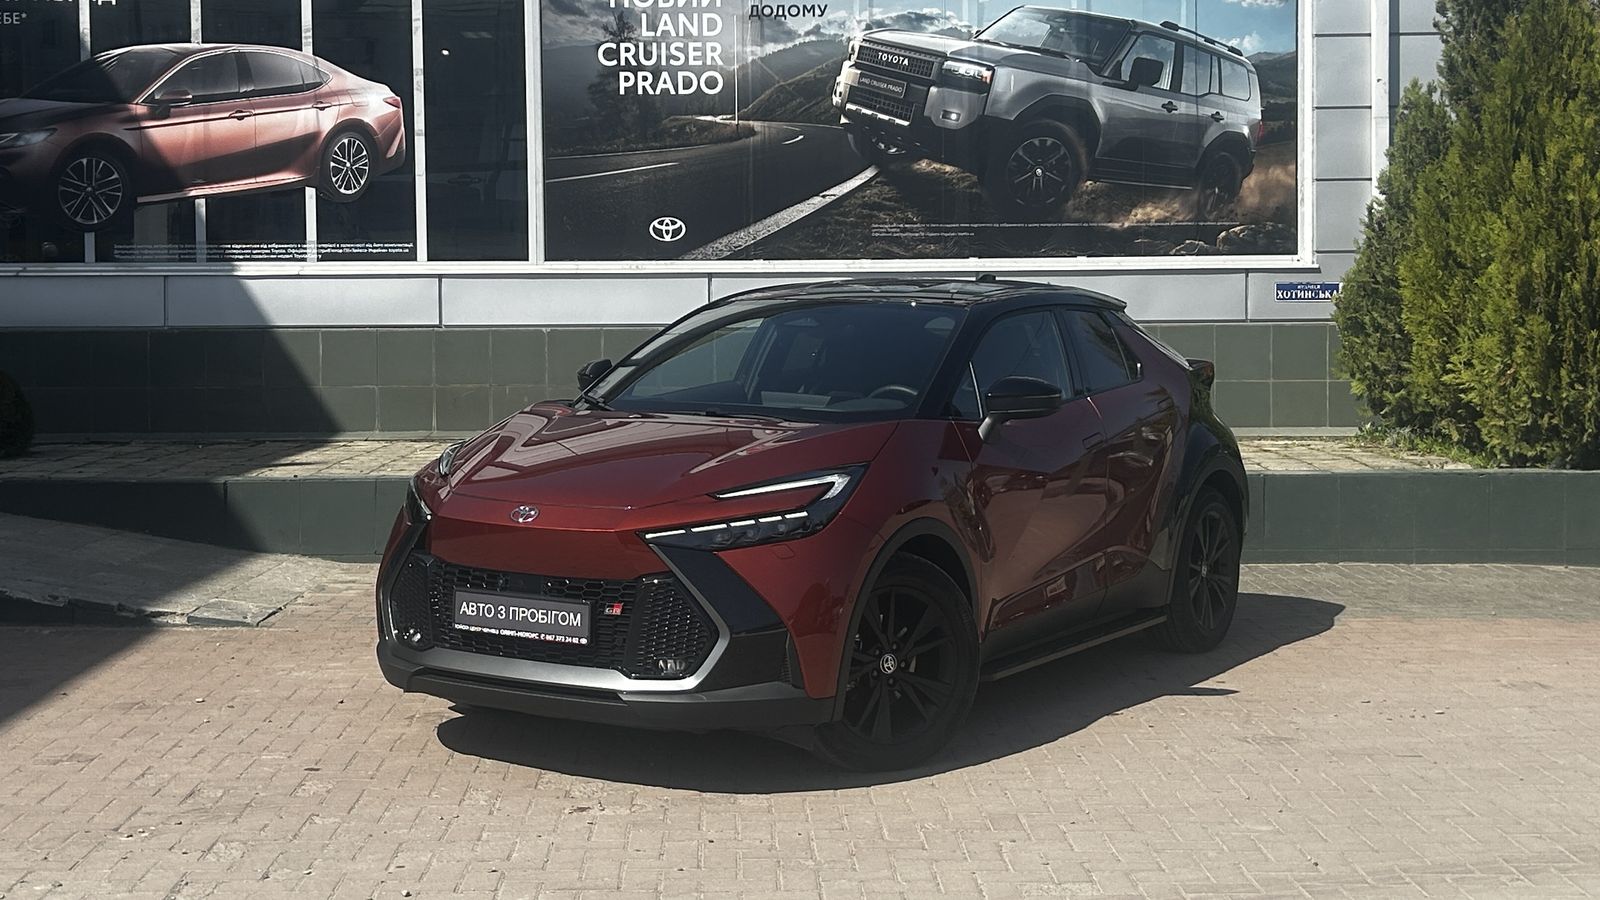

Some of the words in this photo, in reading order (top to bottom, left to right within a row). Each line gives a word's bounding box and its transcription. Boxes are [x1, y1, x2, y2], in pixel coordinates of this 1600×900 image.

[641, 12, 723, 37] LAND
[749, 4, 828, 20] ДОДОМУ
[597, 41, 724, 67] CRUISER
[878, 52, 909, 66] TOYOTA
[619, 70, 724, 96] PRADO
[459, 601, 495, 618] АВТО
[509, 606, 582, 627] ПРОБІГОМ
